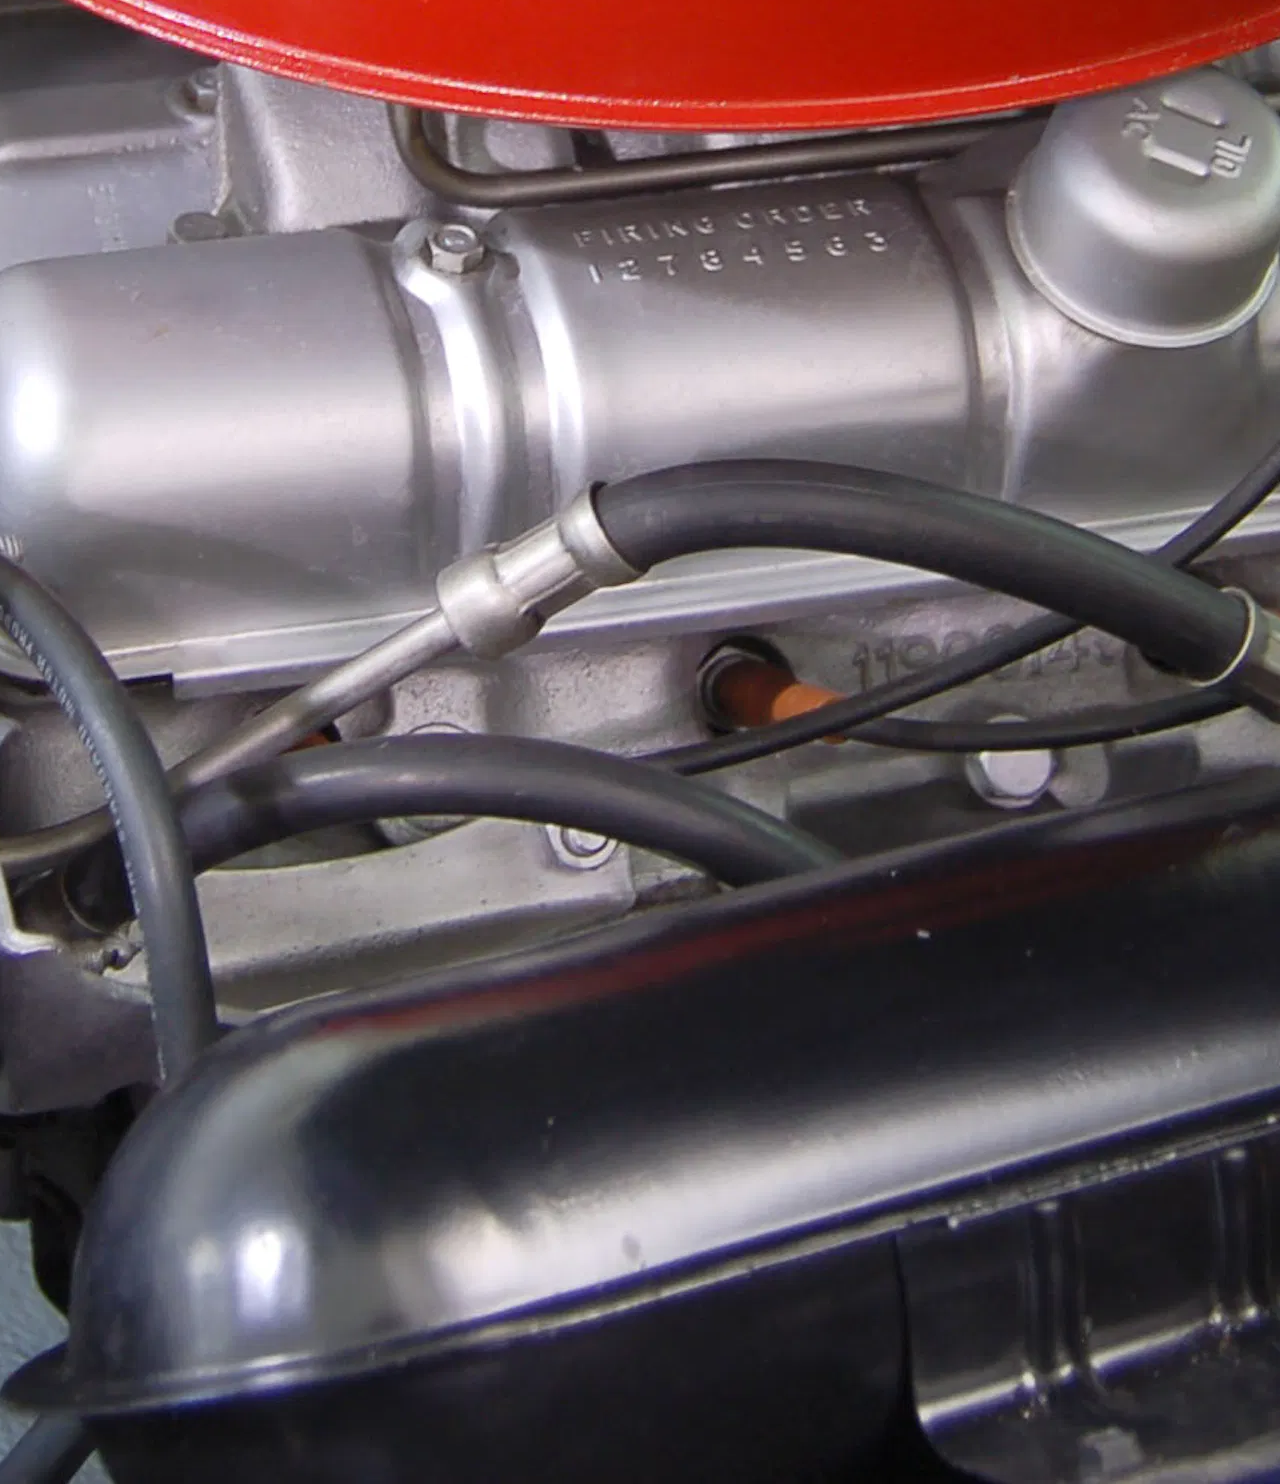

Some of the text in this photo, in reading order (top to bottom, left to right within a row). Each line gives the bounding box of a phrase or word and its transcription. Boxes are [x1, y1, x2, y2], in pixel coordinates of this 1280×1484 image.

[1210, 135, 1252, 178] OIL
[573, 198, 871, 248] FIRING ORDER
